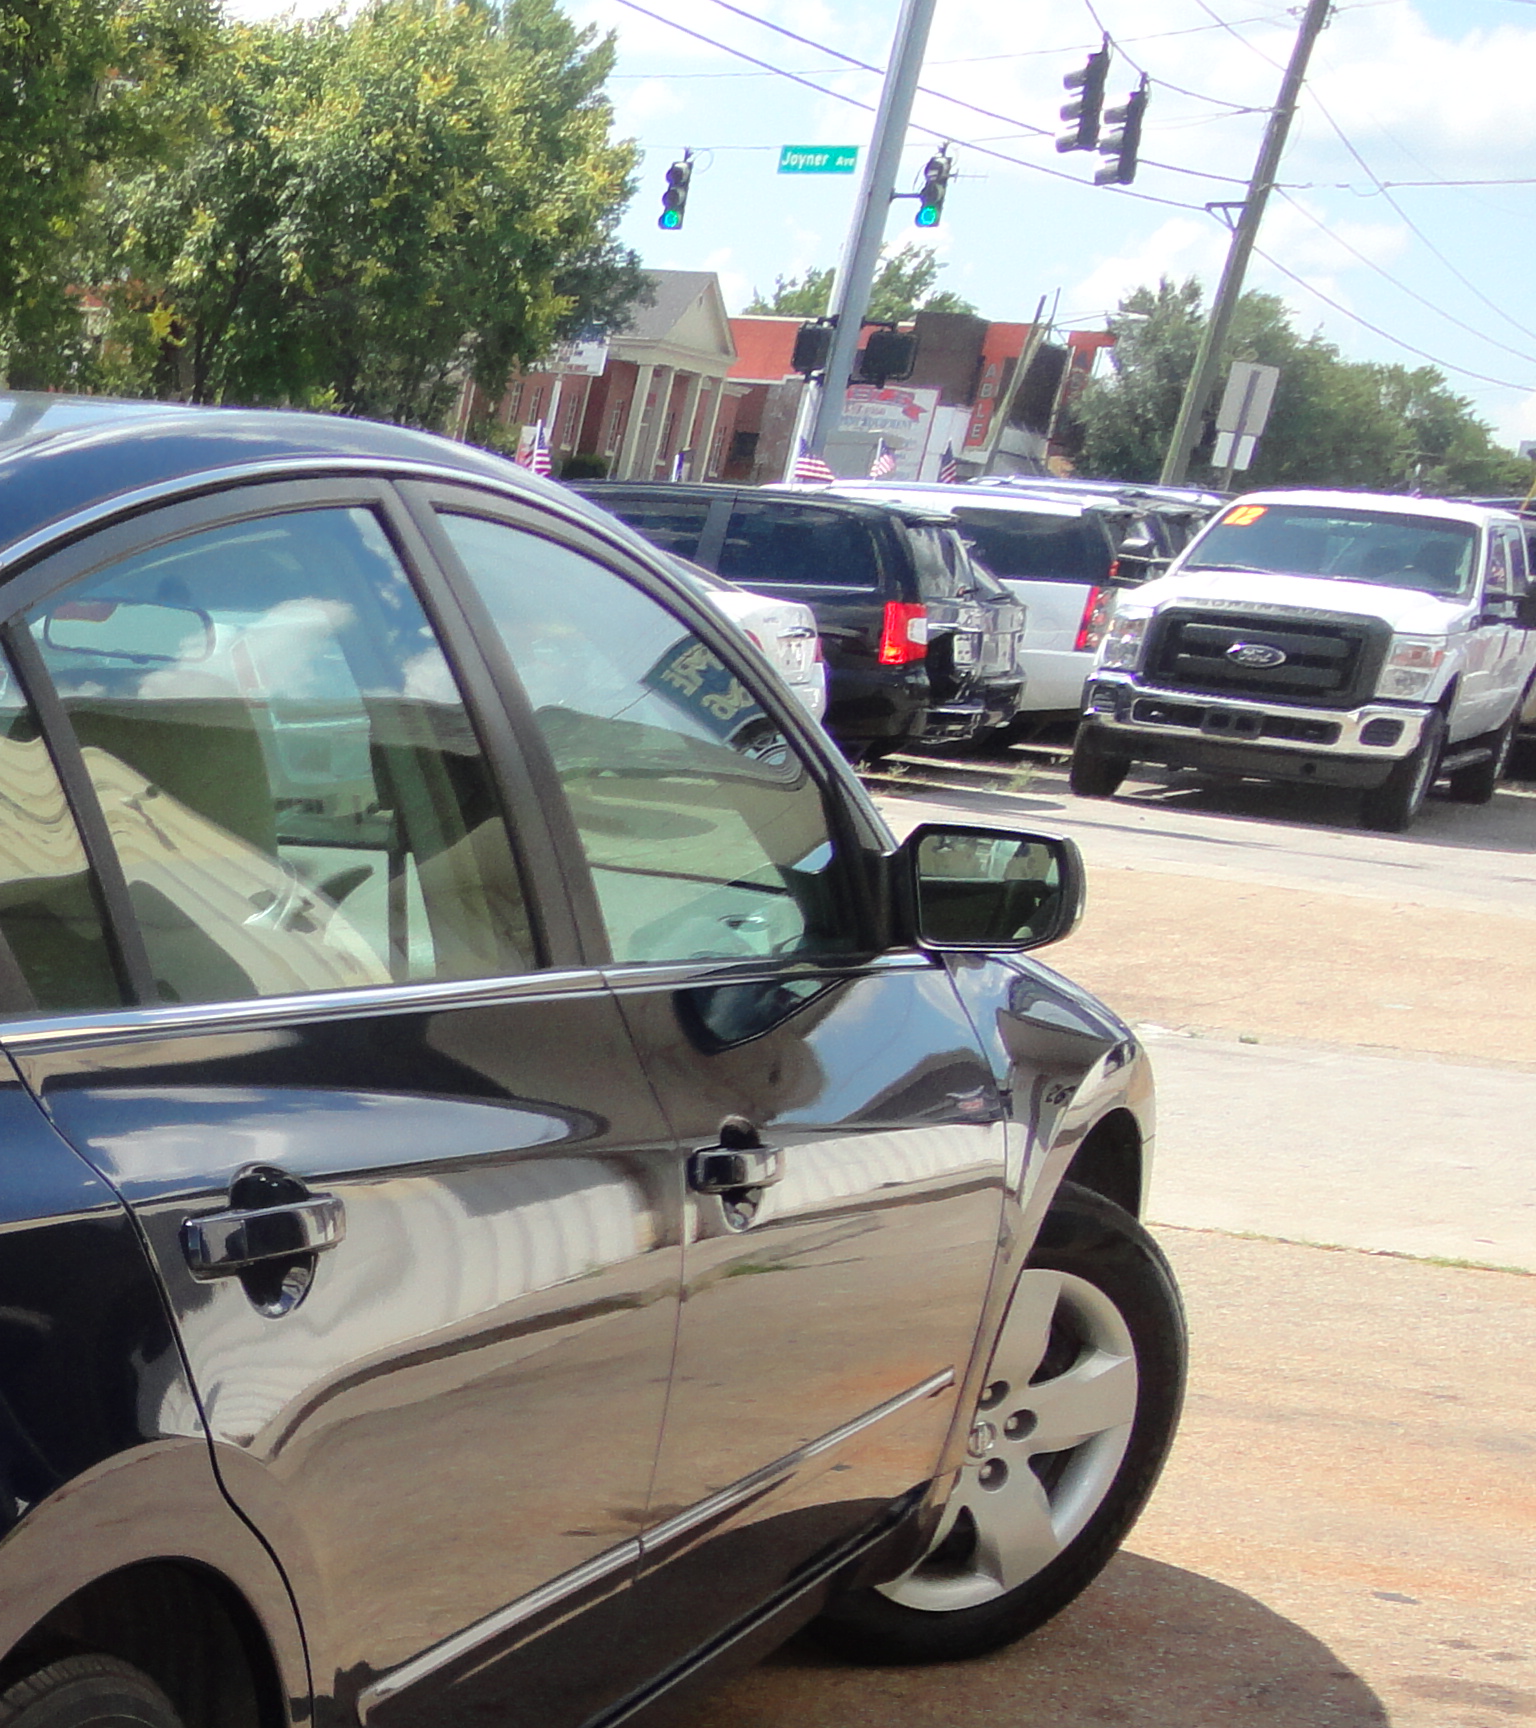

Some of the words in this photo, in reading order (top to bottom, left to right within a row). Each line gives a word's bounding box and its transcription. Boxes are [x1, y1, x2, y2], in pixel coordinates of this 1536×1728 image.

[782, 151, 829, 169] Joyner
[970, 362, 998, 438] ABLE
[1223, 506, 1268, 526] 12
